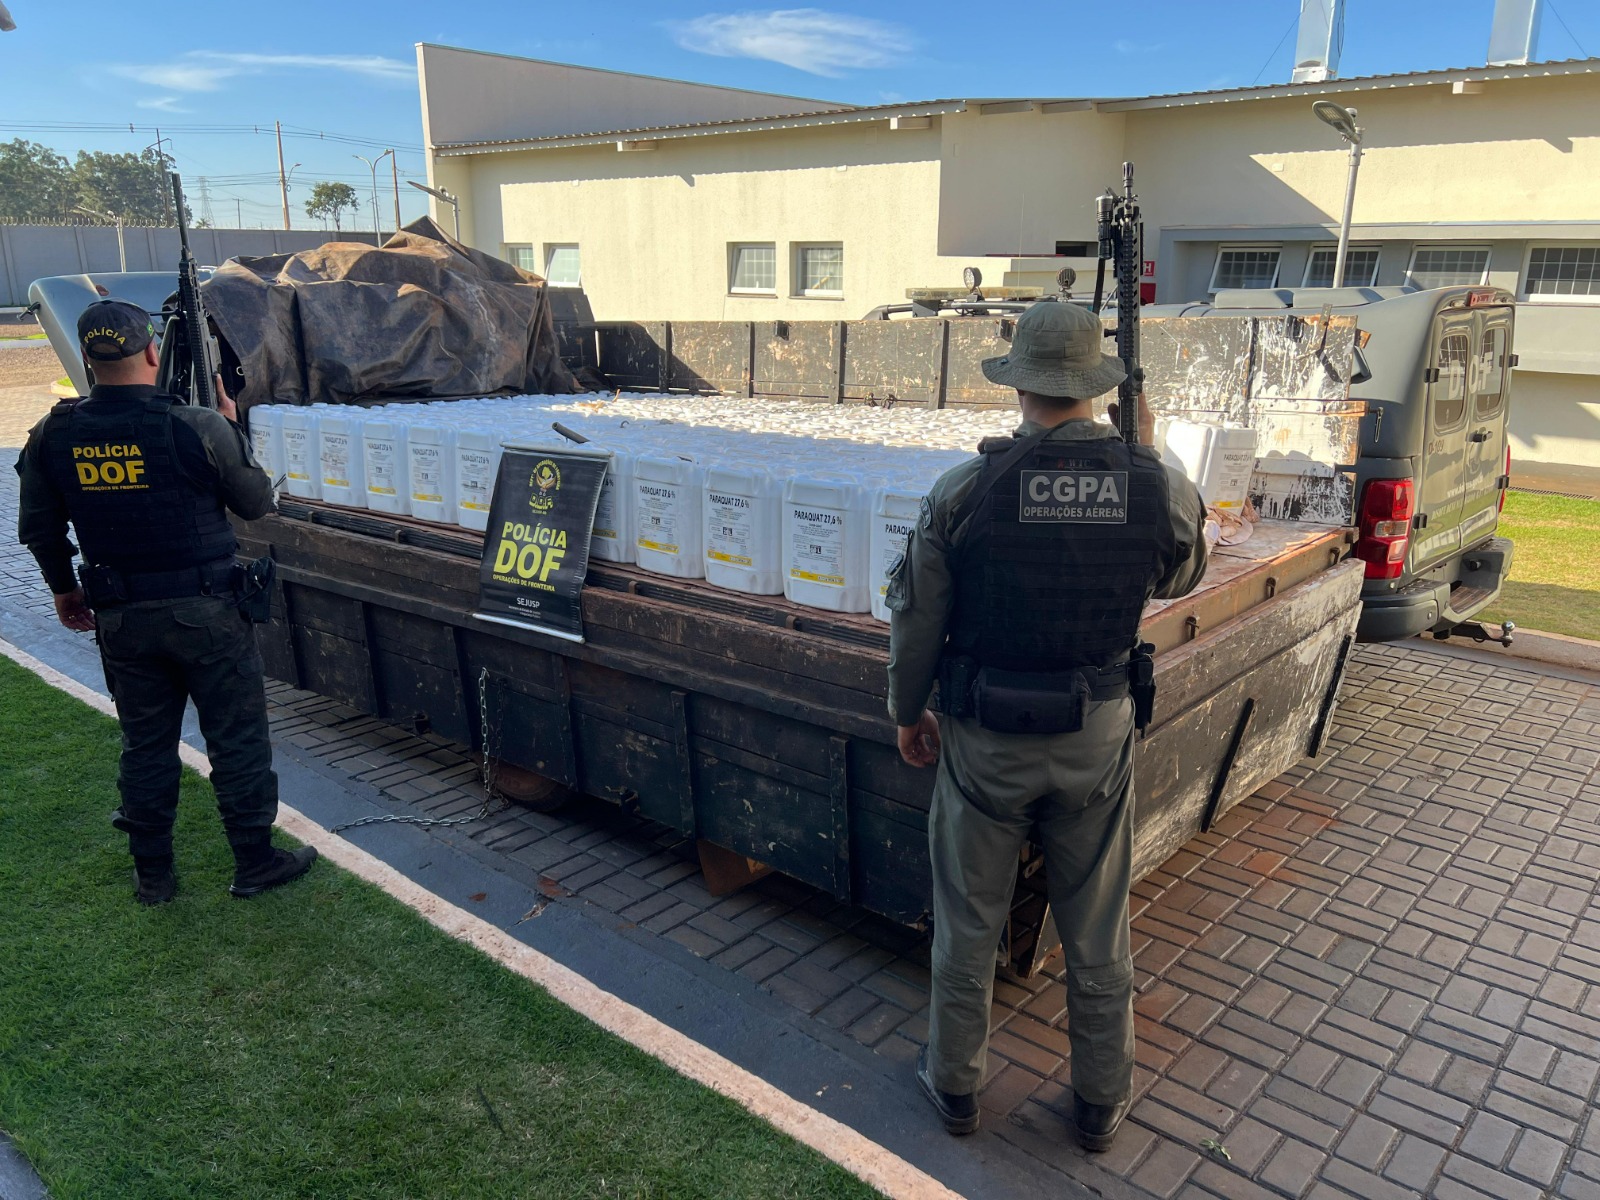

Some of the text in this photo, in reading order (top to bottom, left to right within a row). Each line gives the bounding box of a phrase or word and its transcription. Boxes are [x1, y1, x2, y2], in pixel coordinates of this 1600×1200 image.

[84, 327, 126, 345] POLÍCIA
[72, 443, 142, 459] POLÍCIA
[75, 460, 145, 485] DOF
[639, 485, 662, 497] PARAQUAT
[1028, 475, 1120, 503] CGPA
[709, 494, 734, 506] PARAQUAT
[793, 510, 823, 523] PARAQUAT
[1023, 505, 1125, 519] OPERAÇÕES AÉREAS
[502, 521, 567, 549] POLÍCIA
[493, 539, 566, 582] DOF
[492, 574, 556, 592] OPERAÇÕES DE FRONTEIRA
[516, 597, 540, 608] SEJUSP
